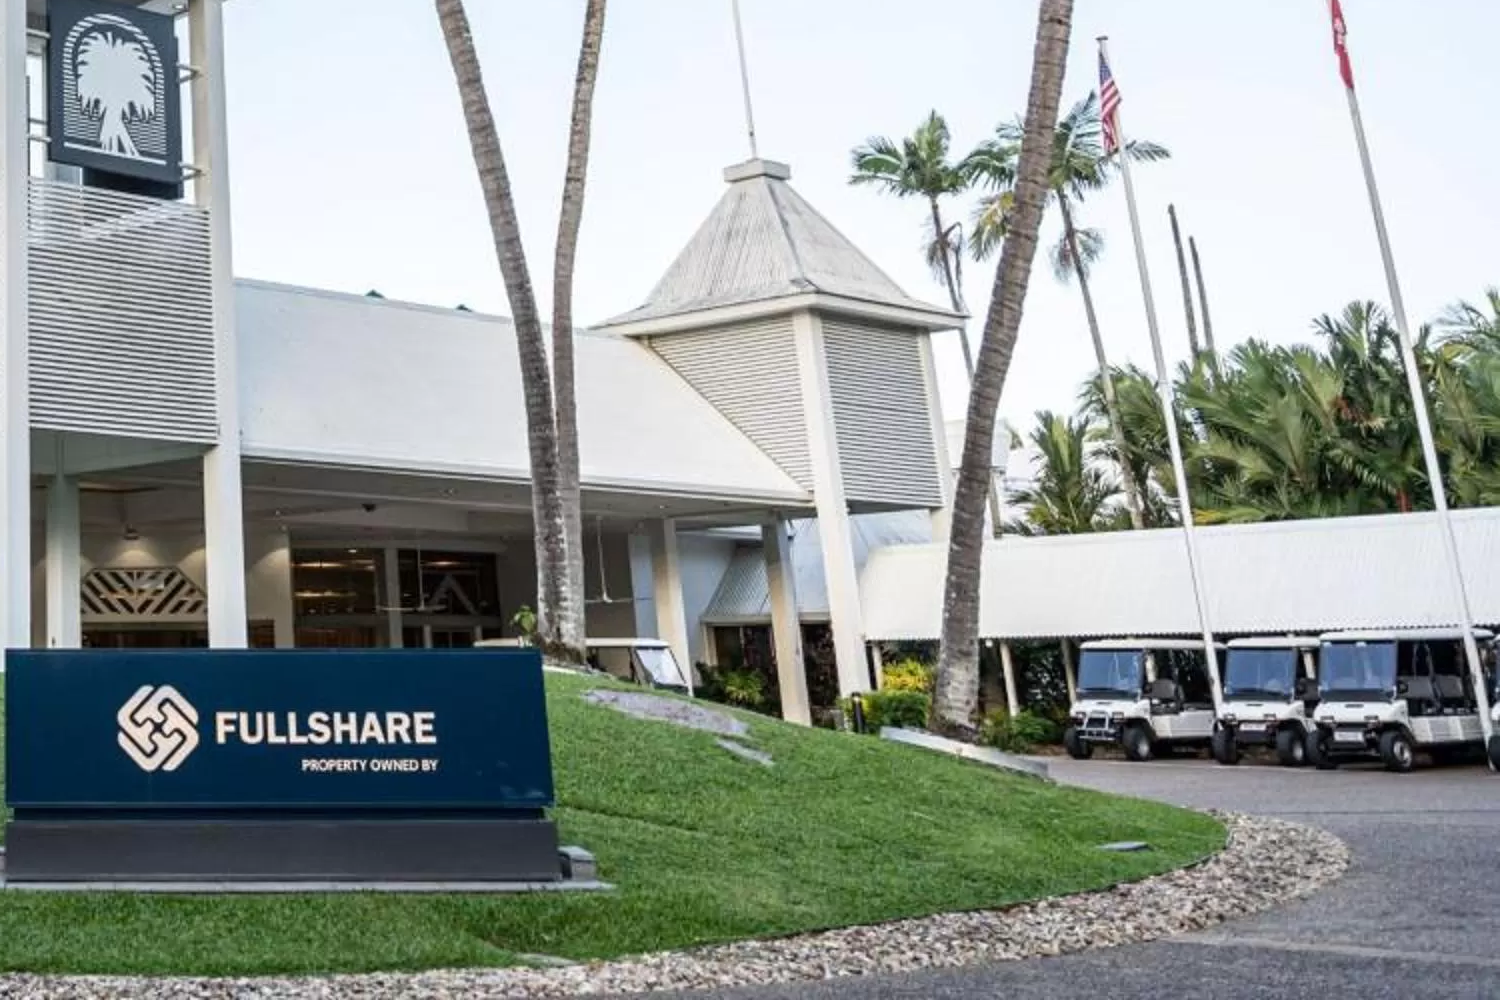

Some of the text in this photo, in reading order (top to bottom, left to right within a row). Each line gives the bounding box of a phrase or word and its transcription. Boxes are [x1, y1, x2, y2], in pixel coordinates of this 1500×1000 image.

[215, 711, 437, 745] FULLSHARE
[301, 758, 439, 772] PROPERTY OWNED BY
